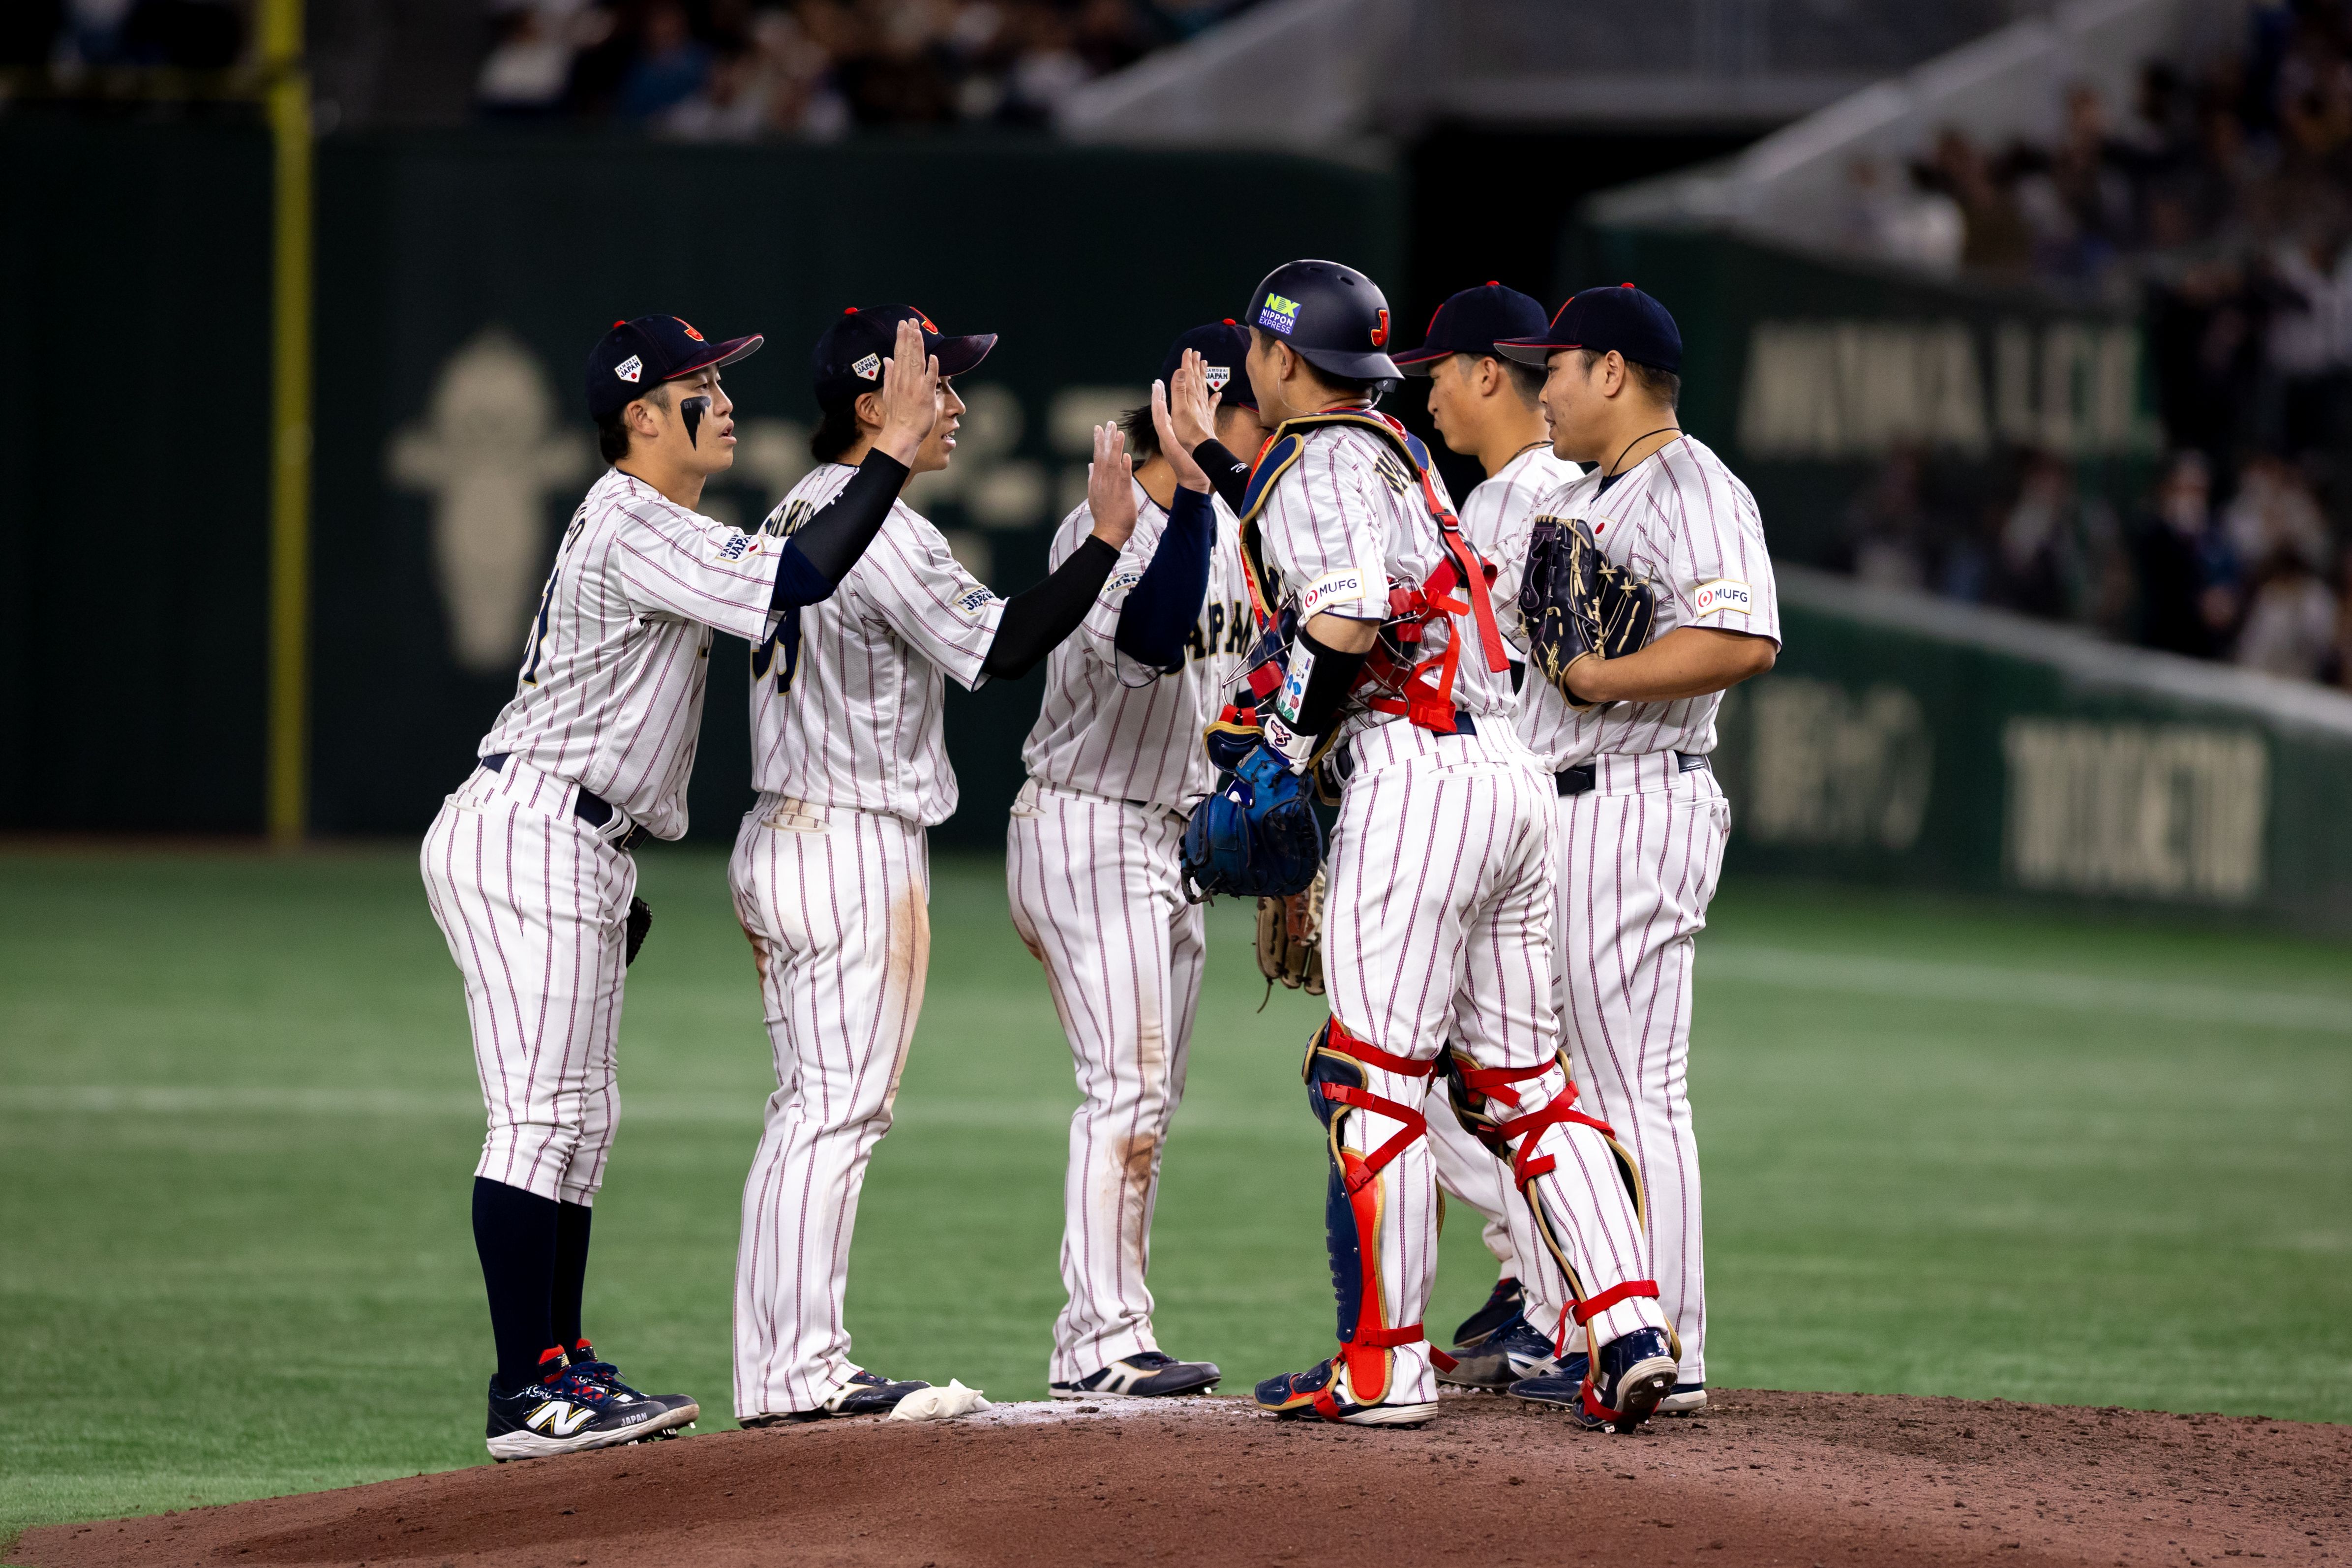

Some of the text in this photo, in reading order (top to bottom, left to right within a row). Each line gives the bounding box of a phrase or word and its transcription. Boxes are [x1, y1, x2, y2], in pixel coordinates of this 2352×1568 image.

[1258, 316, 1292, 334] EXPRESS
[1261, 308, 1294, 327] NIPPON
[1370, 309, 1388, 346] J
[616, 357, 637, 372] SAMURAI
[620, 361, 641, 377] JAPAN
[854, 355, 876, 368] SAMURAI
[857, 359, 879, 374] JAPAN
[1319, 578, 1357, 597] MUFG
[1715, 588, 1748, 603] MUFG
[621, 1412, 648, 1427] JAPAN
